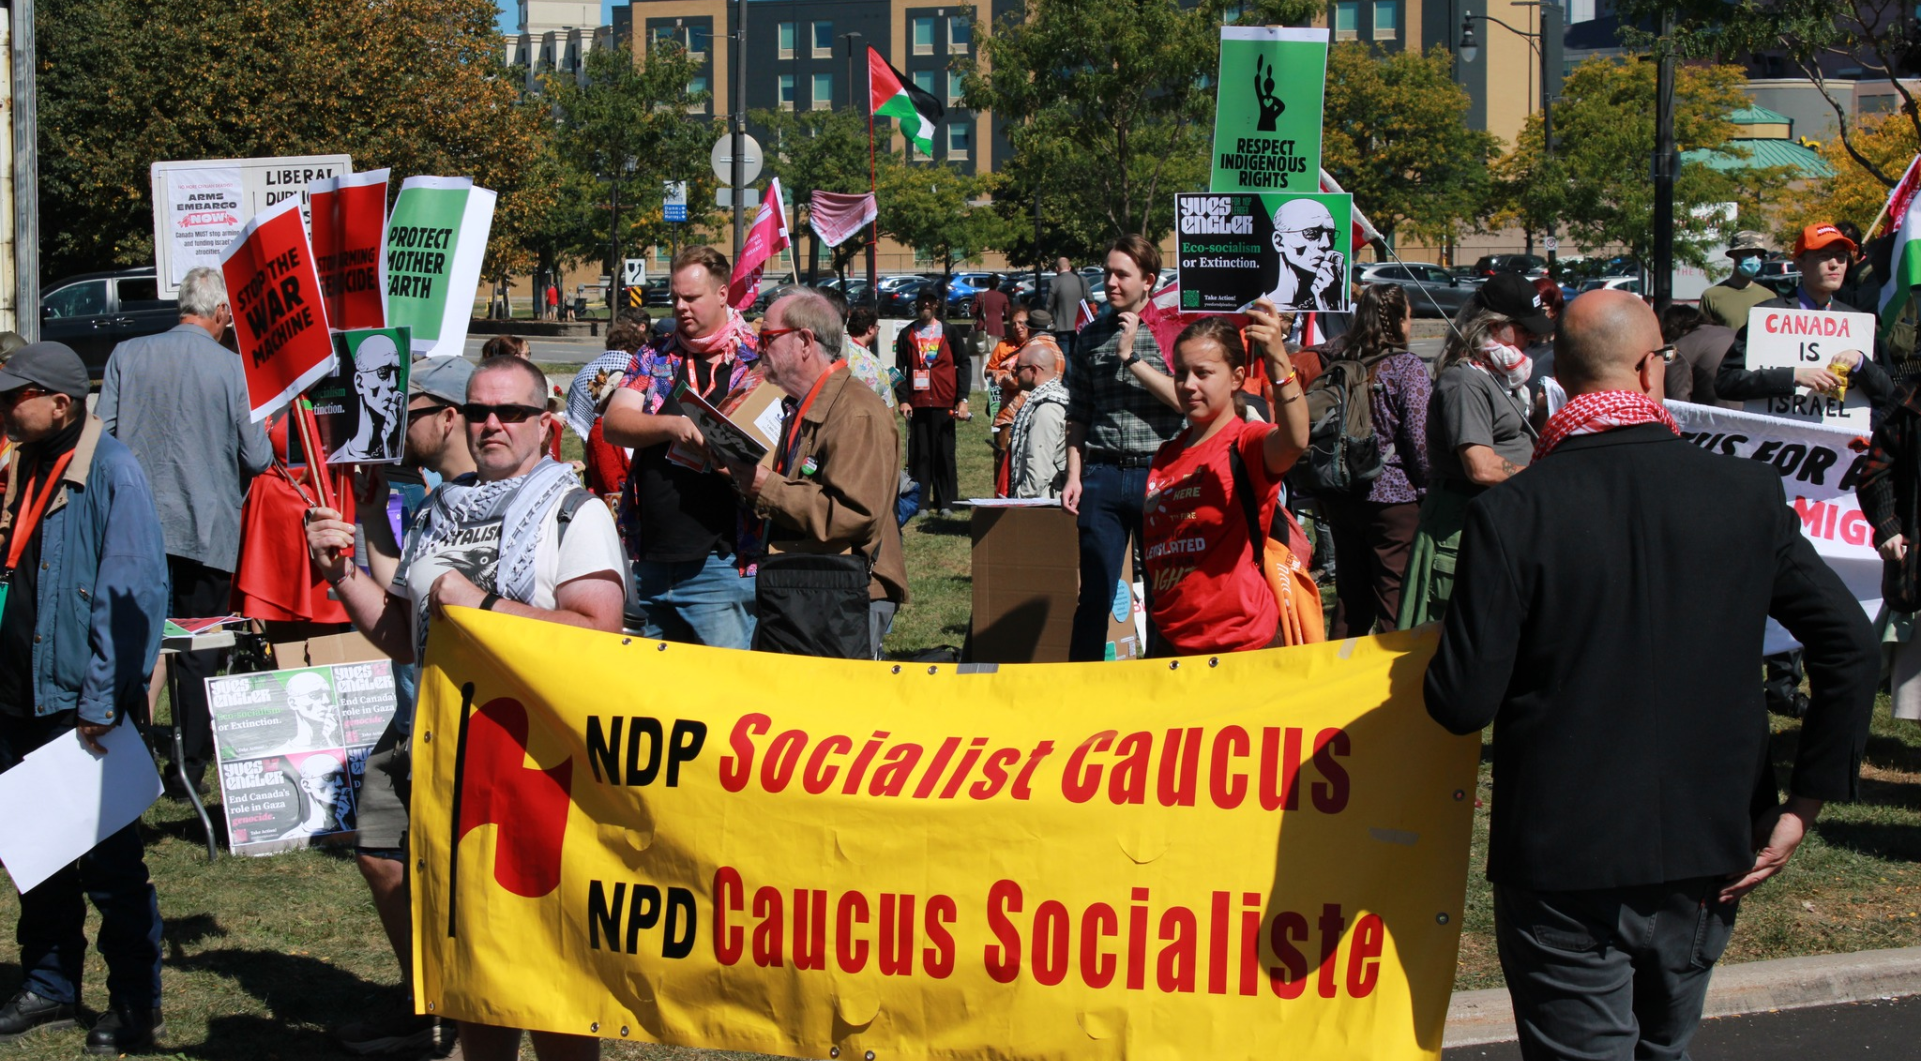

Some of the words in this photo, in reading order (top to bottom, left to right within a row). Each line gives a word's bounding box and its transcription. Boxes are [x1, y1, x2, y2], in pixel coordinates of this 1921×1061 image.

[1236, 138, 1295, 155] RESPECT
[1220, 154, 1306, 173] INDIGENOUS
[1238, 171, 1288, 188] RIGHTS
[188, 193, 224, 201] ARMS
[177, 202, 237, 211] EMBARGO
[388, 226, 452, 250] PROTECT
[1181, 241, 1261, 254] Eco-socialism
[1182, 259, 1197, 268] or
[1199, 257, 1260, 269] Extinction.
[236, 270, 267, 311] STOP
[267, 247, 301, 280] THE
[245, 275, 305, 341] WAR
[1765, 313, 1850, 338] CANADA
[251, 306, 314, 369] MACHINE
[1799, 342, 1820, 362] IS
[1767, 394, 1851, 418] ISRAEL
[1173, 486, 1202, 500] HERE
[1793, 495, 1876, 549] MIG
[340, 696, 358, 706] End
[342, 707, 360, 717] role
[361, 705, 372, 715] in
[373, 704, 395, 713] Gaza
[218, 723, 229, 732] or
[231, 717, 282, 730] Extinction.
[586, 715, 708, 788] NDP
[719, 712, 1055, 801] Socialist
[1060, 724, 1352, 815] Caucus
[228, 793, 248, 804] End
[249, 788, 290, 801] Canada's
[230, 804, 250, 815] role
[251, 803, 261, 812] in
[263, 801, 286, 811] Gaza
[231, 812, 276, 828] genocide.
[587, 879, 697, 960] NPD
[713, 865, 958, 980] Caucus
[983, 878, 1384, 1000] Socialiste
